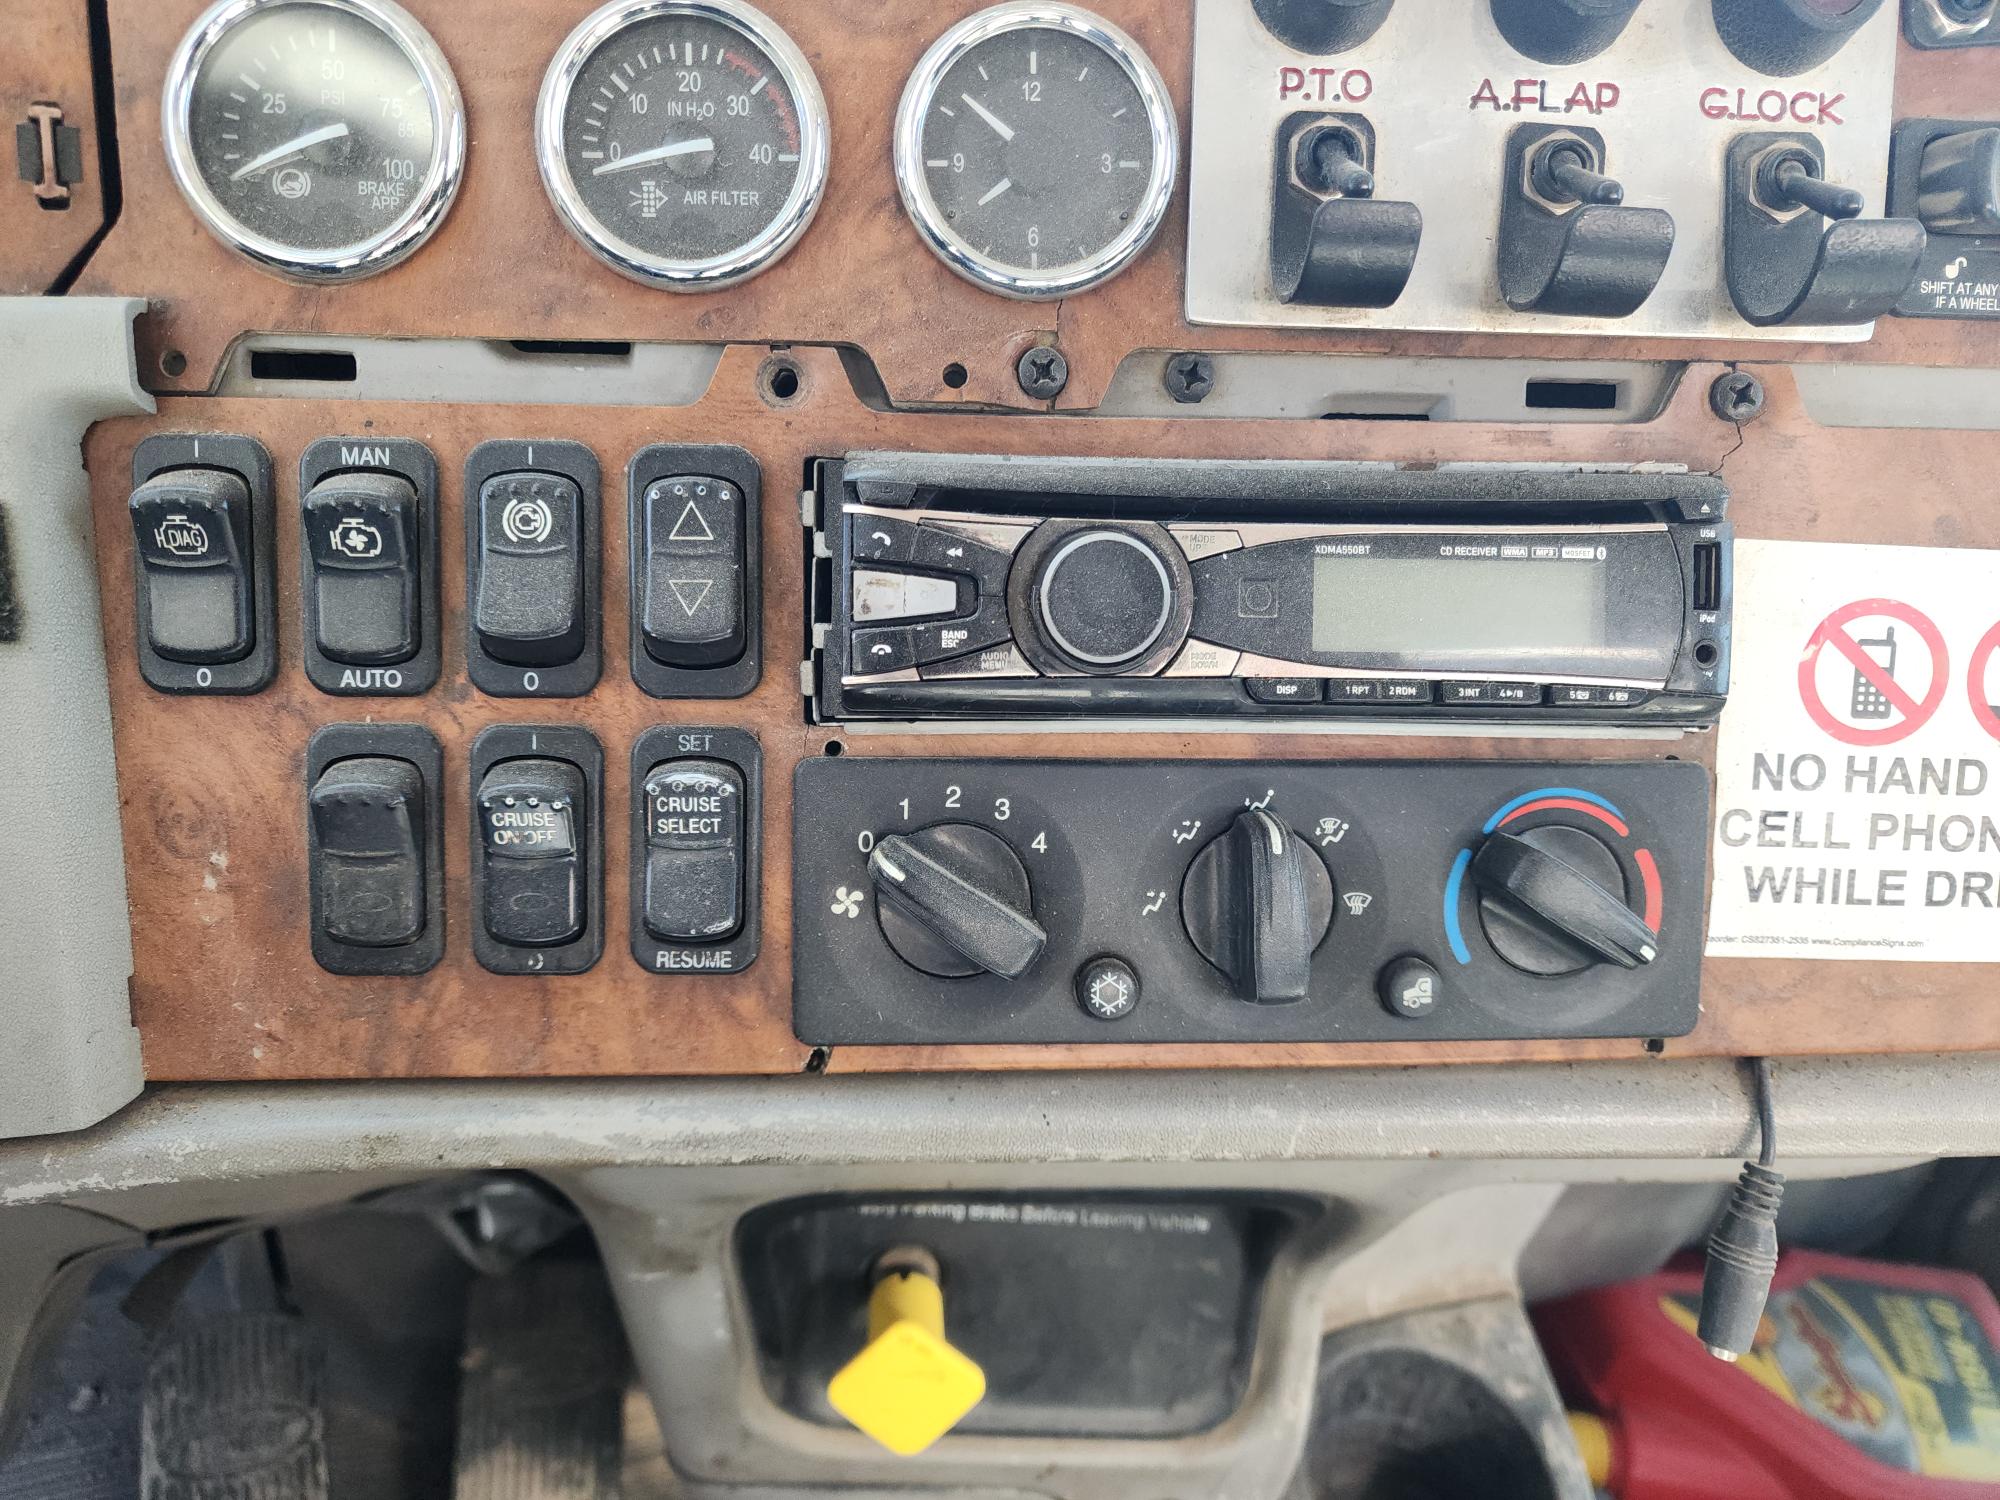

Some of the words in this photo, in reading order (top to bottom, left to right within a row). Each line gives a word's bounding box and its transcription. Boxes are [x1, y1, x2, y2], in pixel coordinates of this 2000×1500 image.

[321, 59, 345, 82] 50
[678, 71, 702, 93] 20
[1279, 66, 1373, 102] P.T.O
[320, 90, 346, 106] PSI
[1021, 81, 1042, 102] 12
[1469, 78, 1621, 115] A.FLAP
[262, 93, 287, 114] 25
[379, 97, 403, 119] 75
[629, 93, 648, 114] 10
[667, 101, 682, 116] IN
[726, 95, 749, 117] 30
[1699, 87, 1847, 126] G.LOCK
[609, 142, 621, 162] 0
[749, 143, 772, 165] 40
[383, 157, 415, 181] 100
[953, 152, 965, 173] 9
[1101, 153, 1113, 174] 3
[357, 181, 405, 197] BRAKE
[370, 196, 400, 211] APP
[683, 190, 706, 206] AIR
[711, 191, 760, 207] FILTER
[1027, 226, 1040, 247] 6
[1920, 280, 1954, 294] SHIFT
[1956, 282, 1973, 295] AT
[1974, 283, 1999, 296] ANY
[1935, 296, 1947, 309] IF
[1948, 297, 1957, 309] A
[1960, 298, 2000, 311] WHEEL
[341, 447, 391, 466] MAN
[168, 531, 201, 548] DIAG
[1189, 534, 1216, 544] MODE
[1700, 528, 1716, 538] USB
[1440, 546, 1453, 556] CD
[1454, 547, 1498, 557] RECEIVER
[1503, 548, 1526, 557] WMA
[1535, 549, 1555, 558] MP3
[1699, 613, 1716, 623] iPod
[941, 630, 968, 640] BAND
[980, 651, 1009, 661] AUDIO
[980, 660, 1008, 670] MENU
[339, 668, 403, 688] AUTO
[1276, 685, 1298, 695] DISP
[1351, 686, 1370, 695] RPT
[1389, 686, 1395, 696] 2
[1395, 686, 1416, 696] RDM
[1458, 687, 1464, 697] 3
[1465, 688, 1481, 698] INT
[678, 735, 714, 752] SET
[1752, 752, 1827, 792] NO
[1844, 755, 1988, 797] HAND
[656, 796, 722, 814] CRUISE
[945, 786, 961, 808] 2
[899, 798, 909, 821] 1
[994, 798, 1010, 821] 3
[491, 811, 557, 828] CRUISE
[657, 818, 721, 835] SELECT
[493, 830, 558, 846] ONOFF
[1719, 809, 1851, 850] CELL
[857, 830, 874, 853] 0
[1031, 831, 1048, 855] 4
[1744, 865, 1908, 908] WHILE
[656, 951, 732, 969] RESUME
